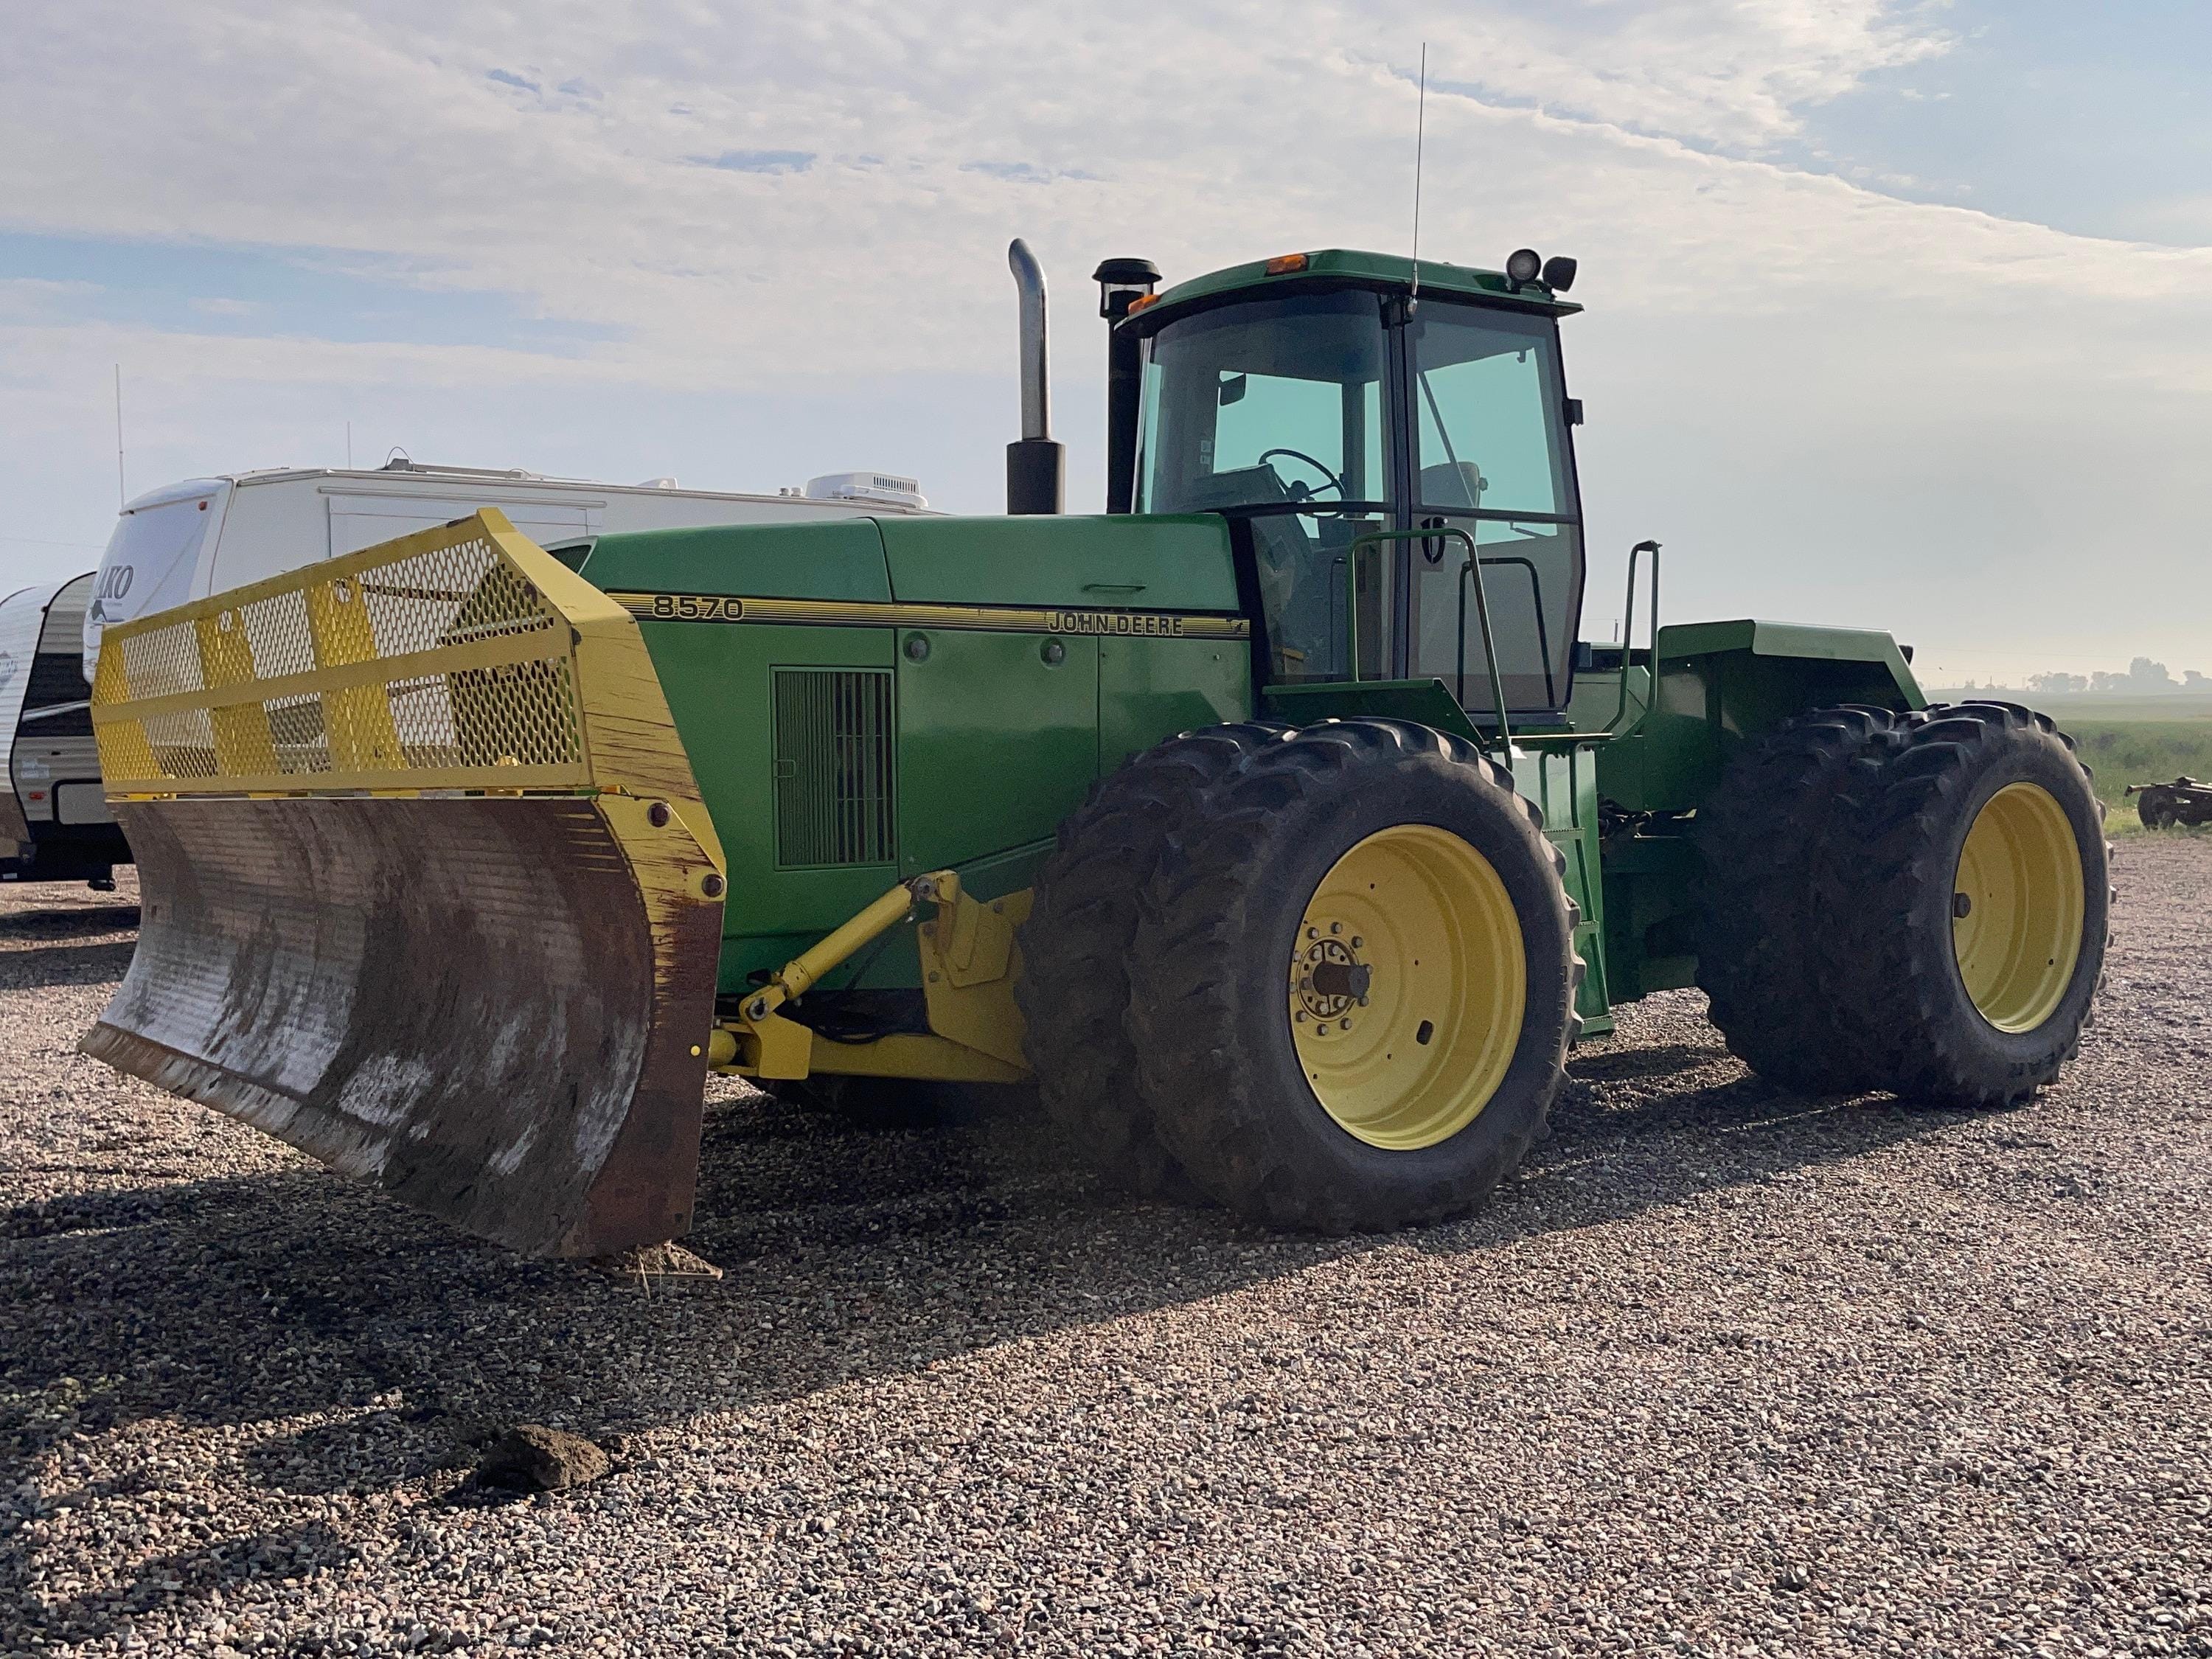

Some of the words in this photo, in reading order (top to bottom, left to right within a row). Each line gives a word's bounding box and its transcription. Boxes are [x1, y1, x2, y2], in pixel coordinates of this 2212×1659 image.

[653, 595, 743, 620] 8570
[1048, 612, 1109, 633] JOHN
[1116, 615, 1183, 636] DEERE
